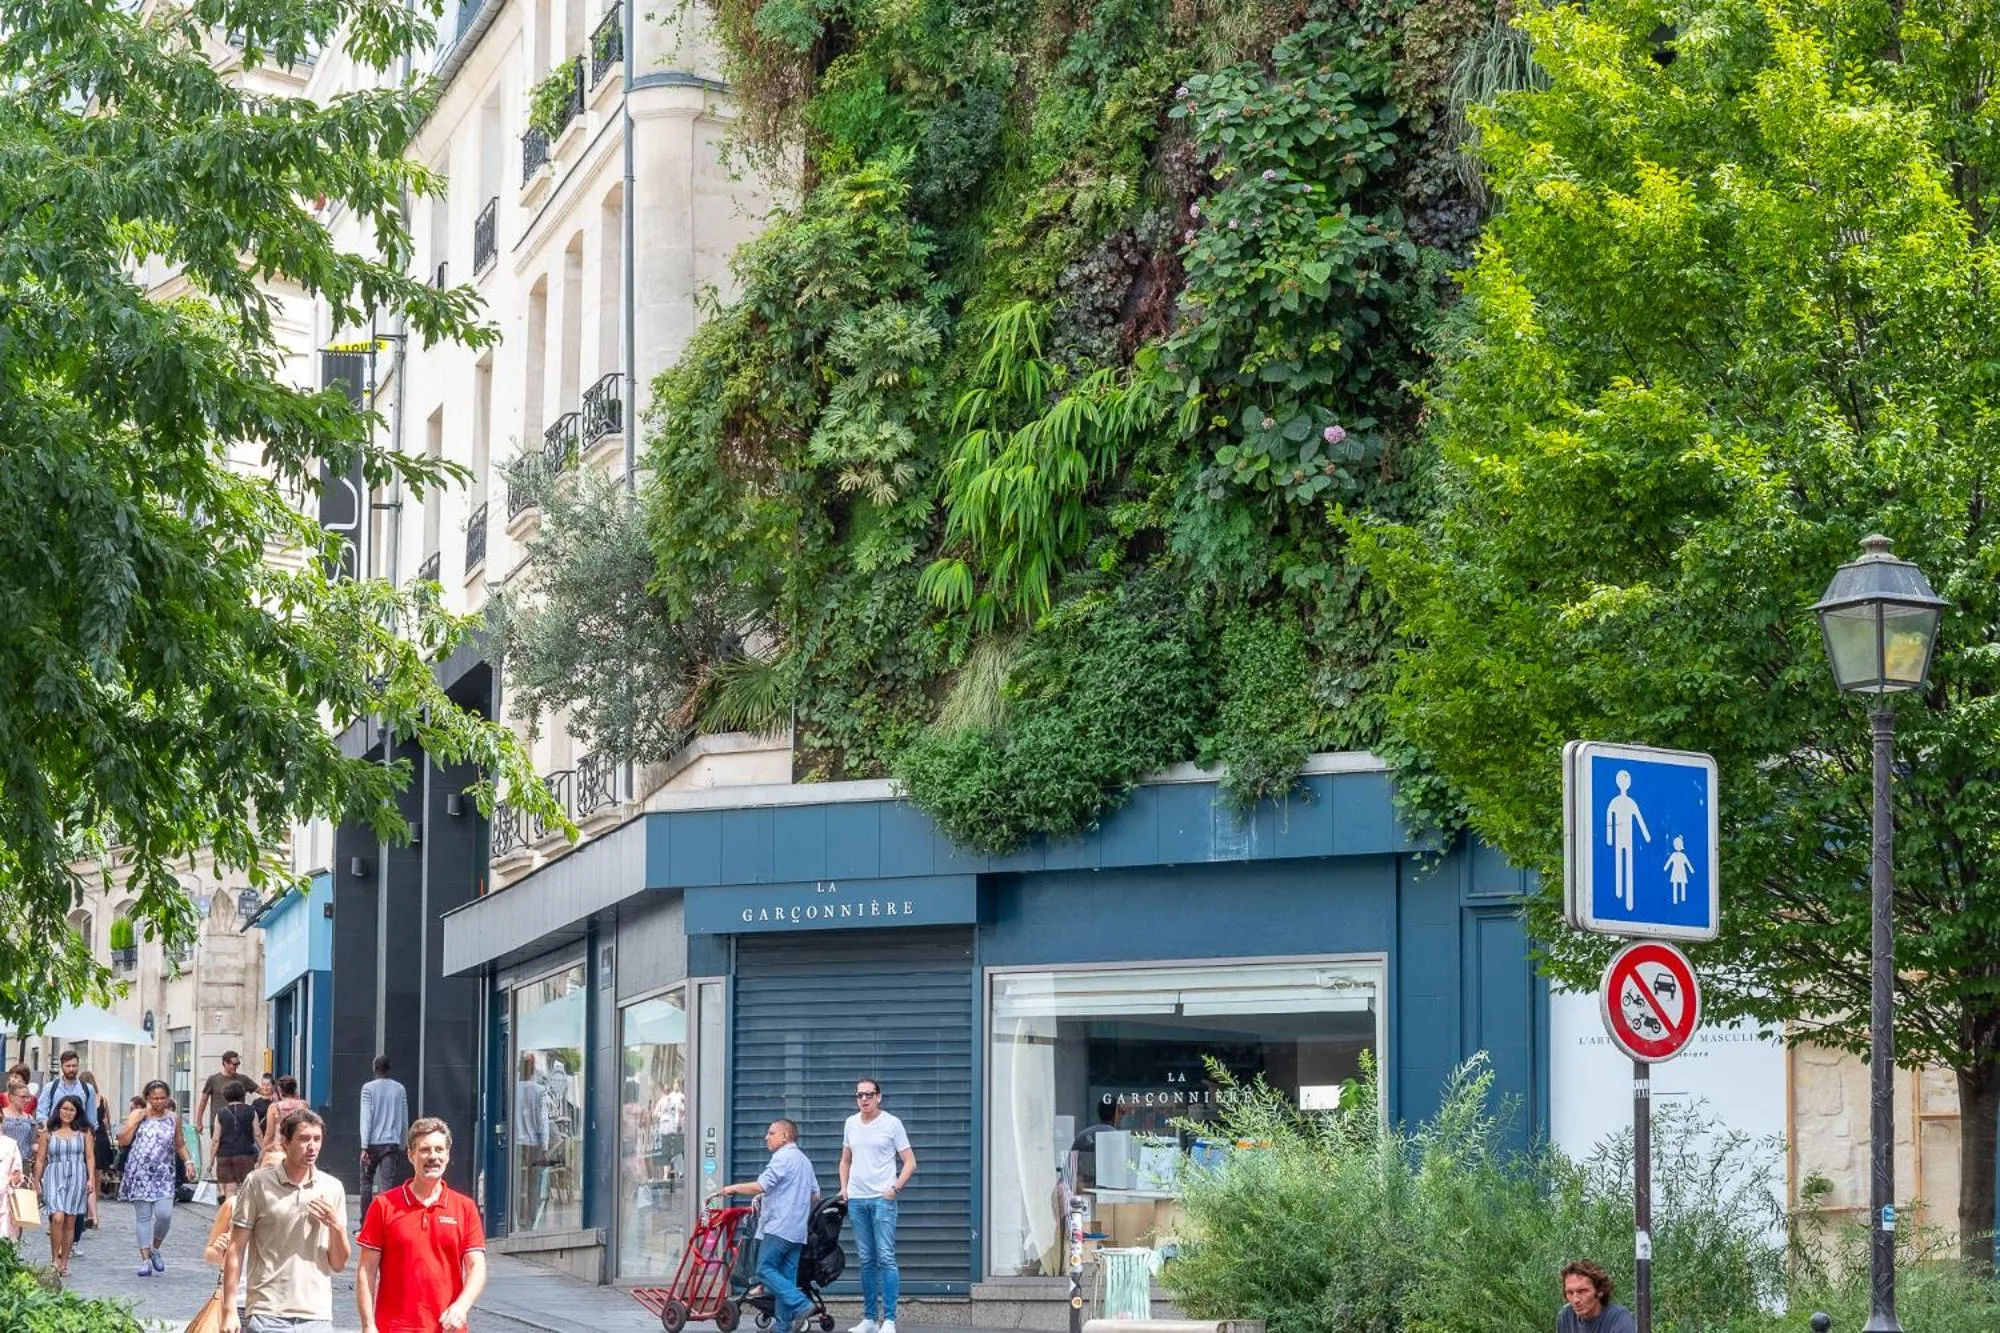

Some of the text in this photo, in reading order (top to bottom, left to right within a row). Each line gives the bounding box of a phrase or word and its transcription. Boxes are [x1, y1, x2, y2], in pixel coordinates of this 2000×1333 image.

[817, 881, 837, 893] LA
[742, 899, 913, 923] GARÇONNIÈRE
[1167, 1072, 1187, 1082] LA
